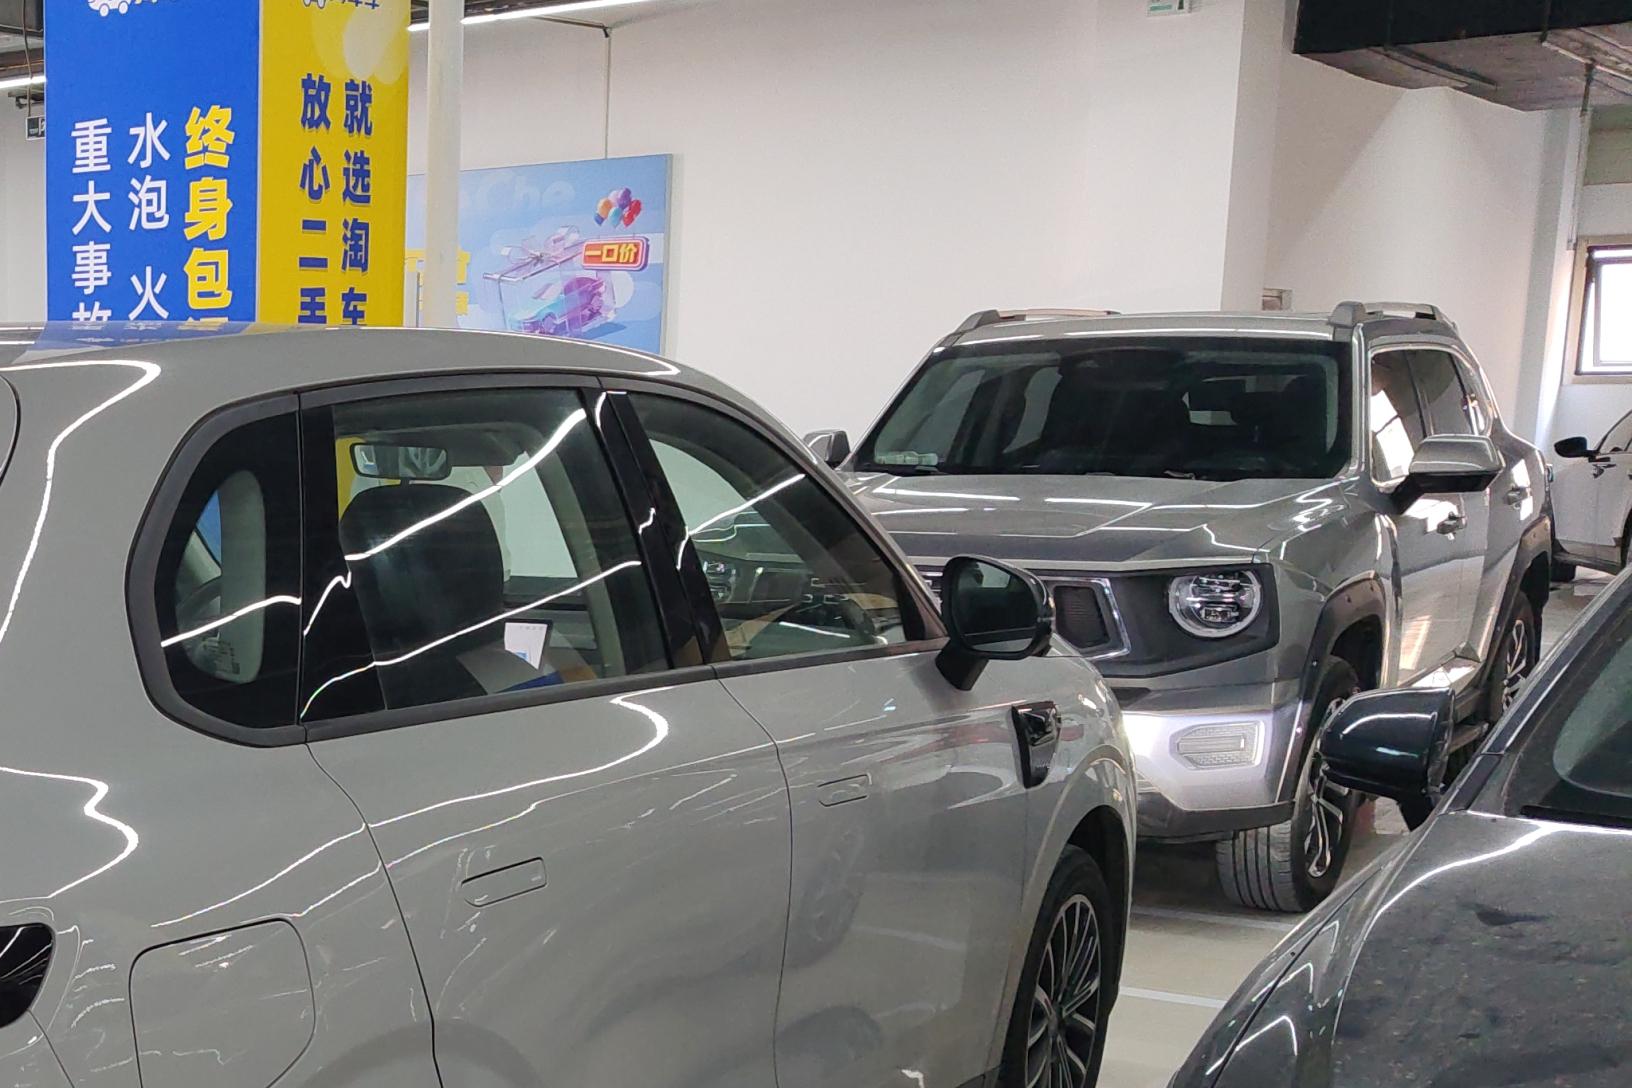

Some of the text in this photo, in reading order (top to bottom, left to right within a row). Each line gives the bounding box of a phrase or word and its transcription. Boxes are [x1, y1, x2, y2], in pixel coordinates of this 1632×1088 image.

[127, 112, 171, 231] 水泡
[183, 104, 235, 322] 终身包
[584, 243, 637, 263] 一口价
